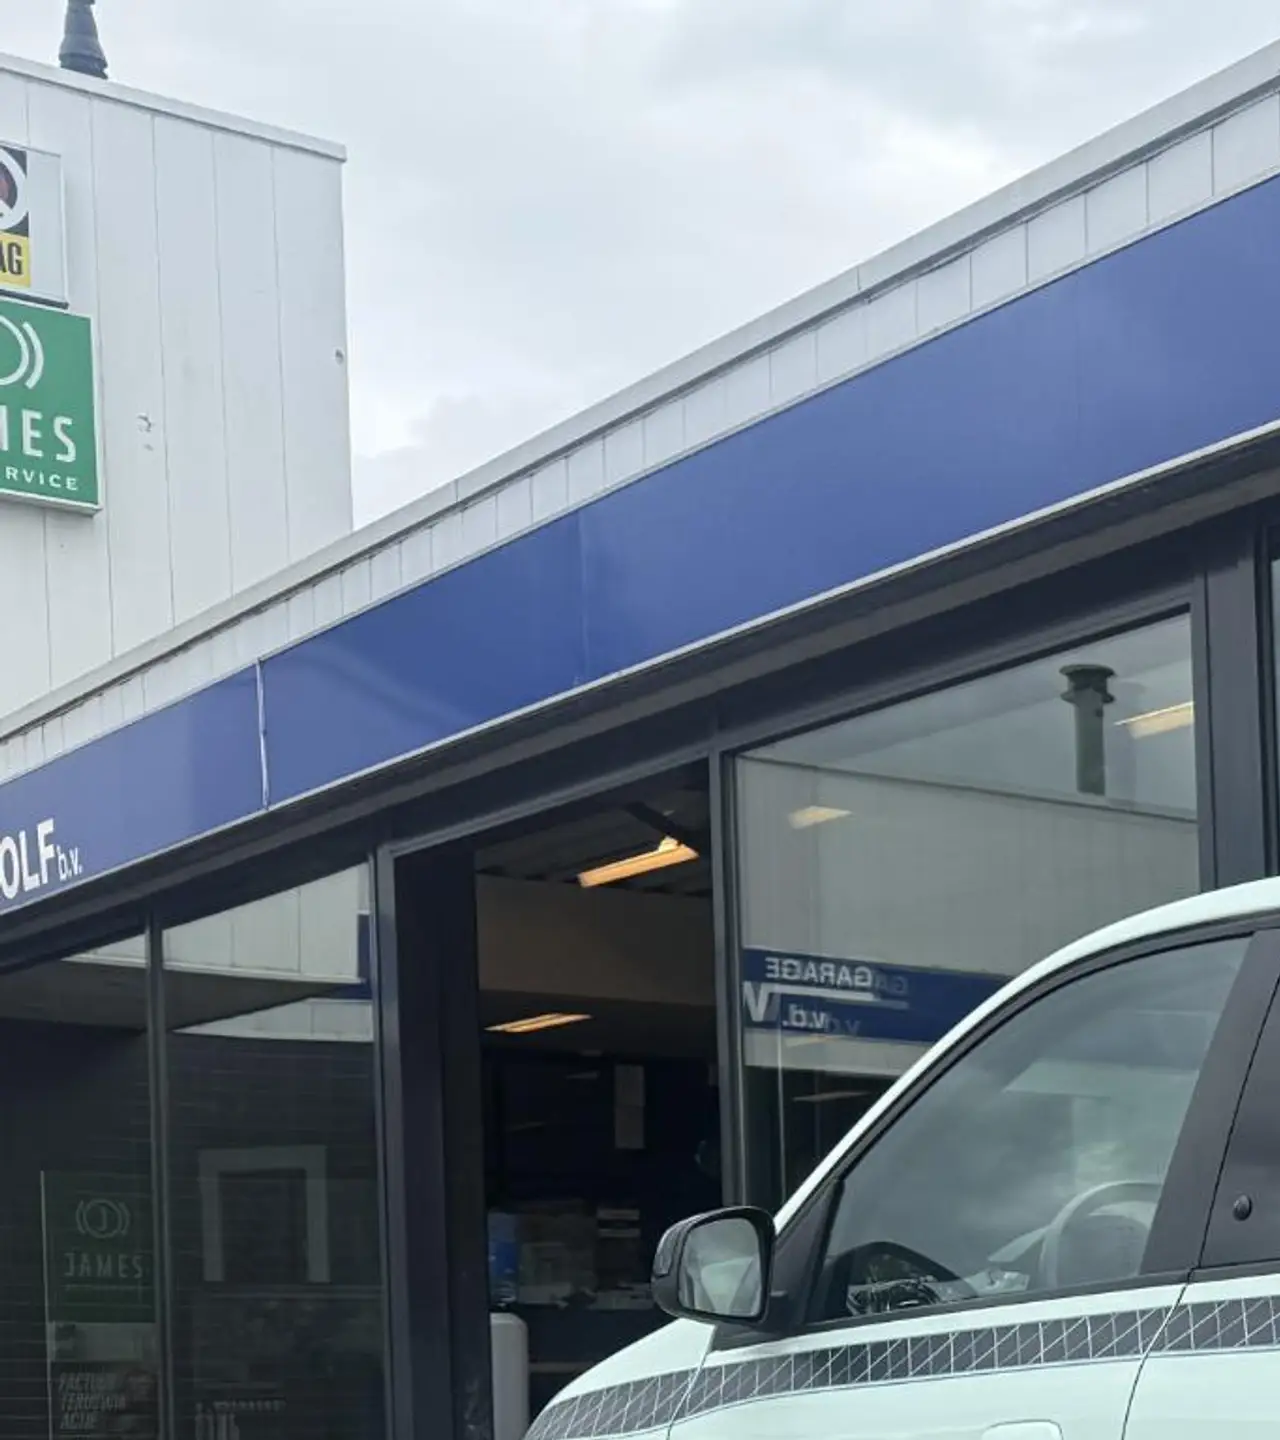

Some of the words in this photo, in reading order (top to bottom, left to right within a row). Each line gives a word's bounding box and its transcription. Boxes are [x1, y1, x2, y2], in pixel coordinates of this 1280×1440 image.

[0, 404, 76, 463] ES
[5, 465, 79, 491] RVICE
[64, 1252, 142, 1279] JAMES
